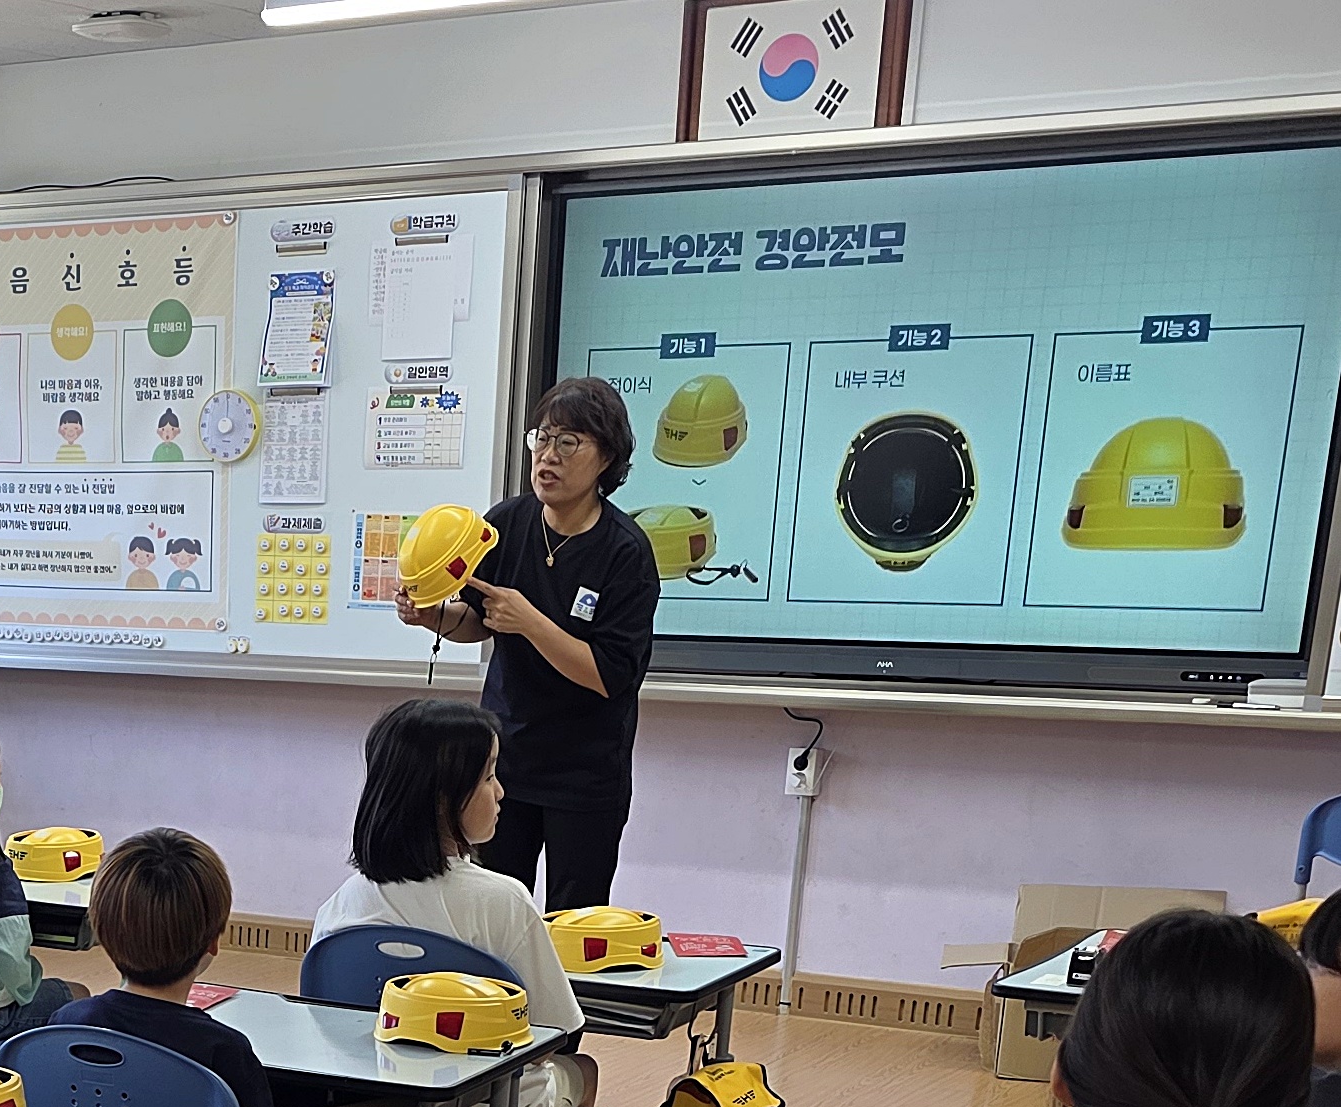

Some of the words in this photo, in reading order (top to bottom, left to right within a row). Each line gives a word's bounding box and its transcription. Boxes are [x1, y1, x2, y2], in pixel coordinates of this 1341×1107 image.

[412, 214, 455, 229] 학급규칙
[291, 221, 333, 236] 주간학습
[600, 231, 744, 277] 재난안전
[755, 222, 906, 271] 경안전모
[152, 321, 186, 333] 표현해요!
[407, 365, 448, 378] 일인일역
[1077, 363, 1132, 383] 이름표
[40, 379, 56, 390] 나의
[58, 379, 82, 390] 마음과
[84, 378, 103, 391] 이유,
[133, 377, 157, 388] 생각한
[160, 376, 183, 387] 내용을
[834, 370, 868, 390] 내부
[871, 369, 905, 389] 쿠션
[68, 391, 100, 402] 생각해요
[135, 389, 161, 401] 말하고
[54, 484, 62, 494] 수
[64, 483, 79, 494] 있는
[13, 503, 35, 514] 보다는
[38, 503, 61, 514] 지금의
[63, 503, 87, 514] 상황과
[89, 503, 105, 514] 나의
[281, 517, 323, 530] 과제제출
